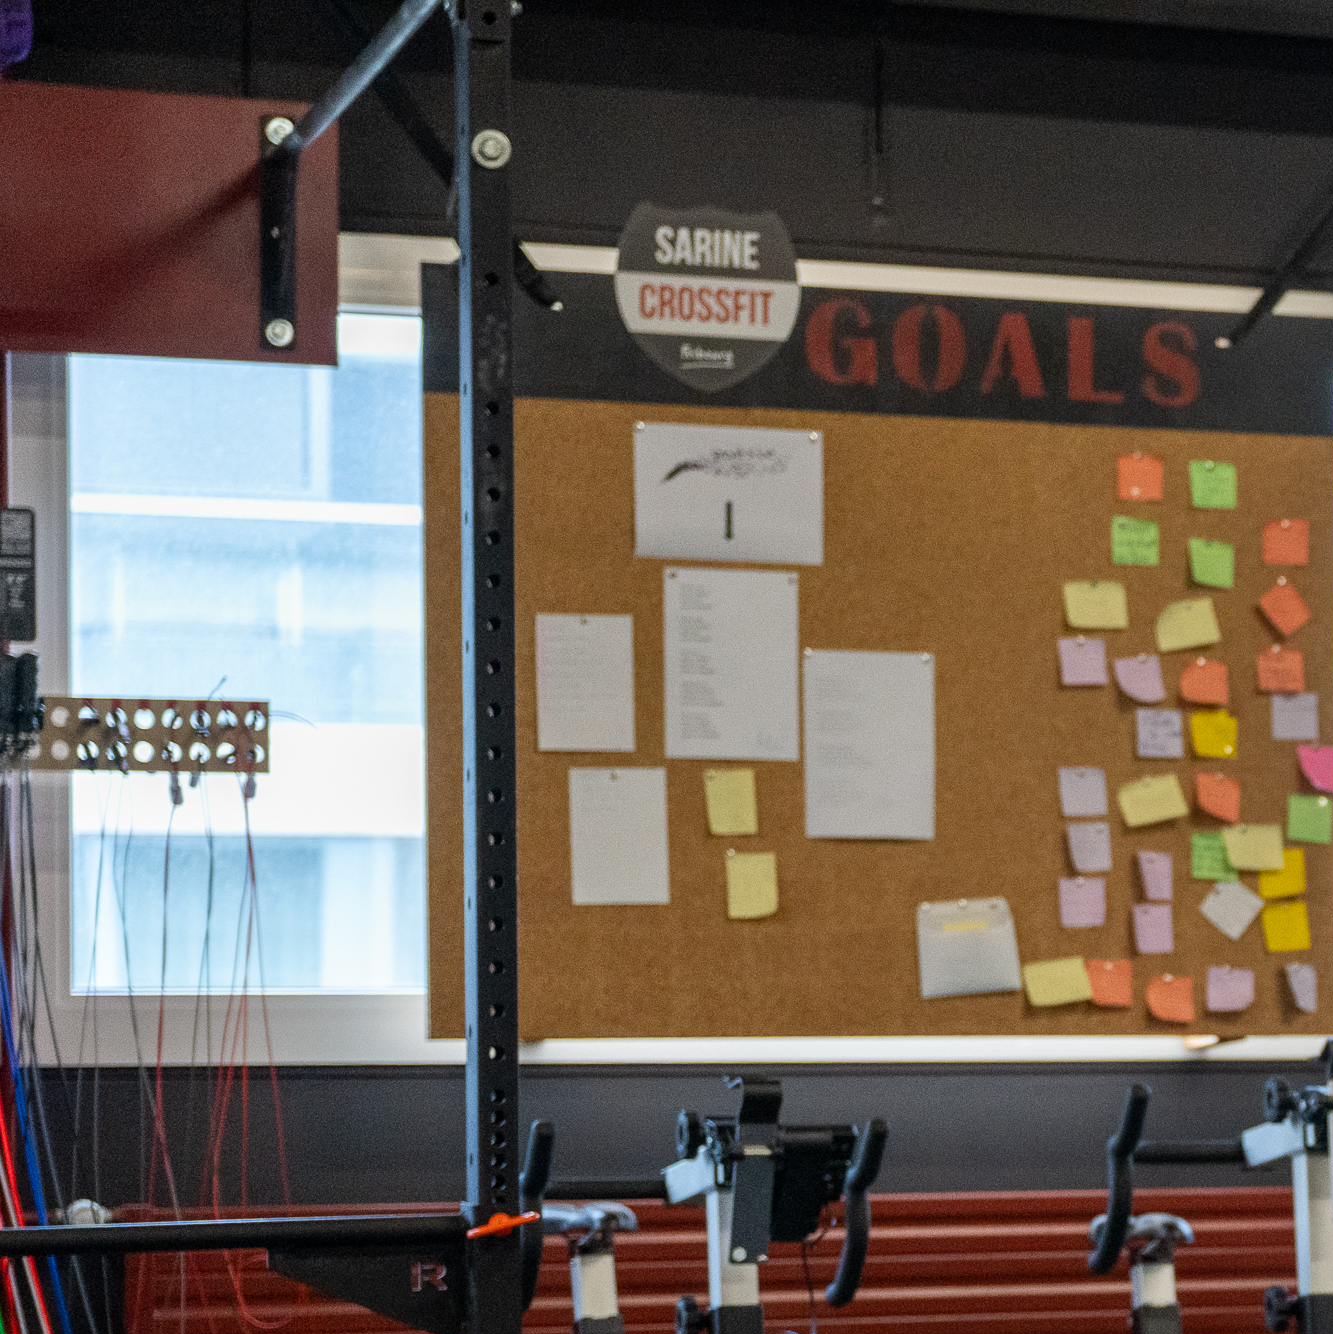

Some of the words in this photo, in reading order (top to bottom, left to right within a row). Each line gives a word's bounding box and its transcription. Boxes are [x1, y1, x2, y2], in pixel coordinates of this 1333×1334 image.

[655, 225, 761, 271] SARINE
[638, 283, 774, 327] CROSSFIT
[804, 297, 1200, 408] GOALS
